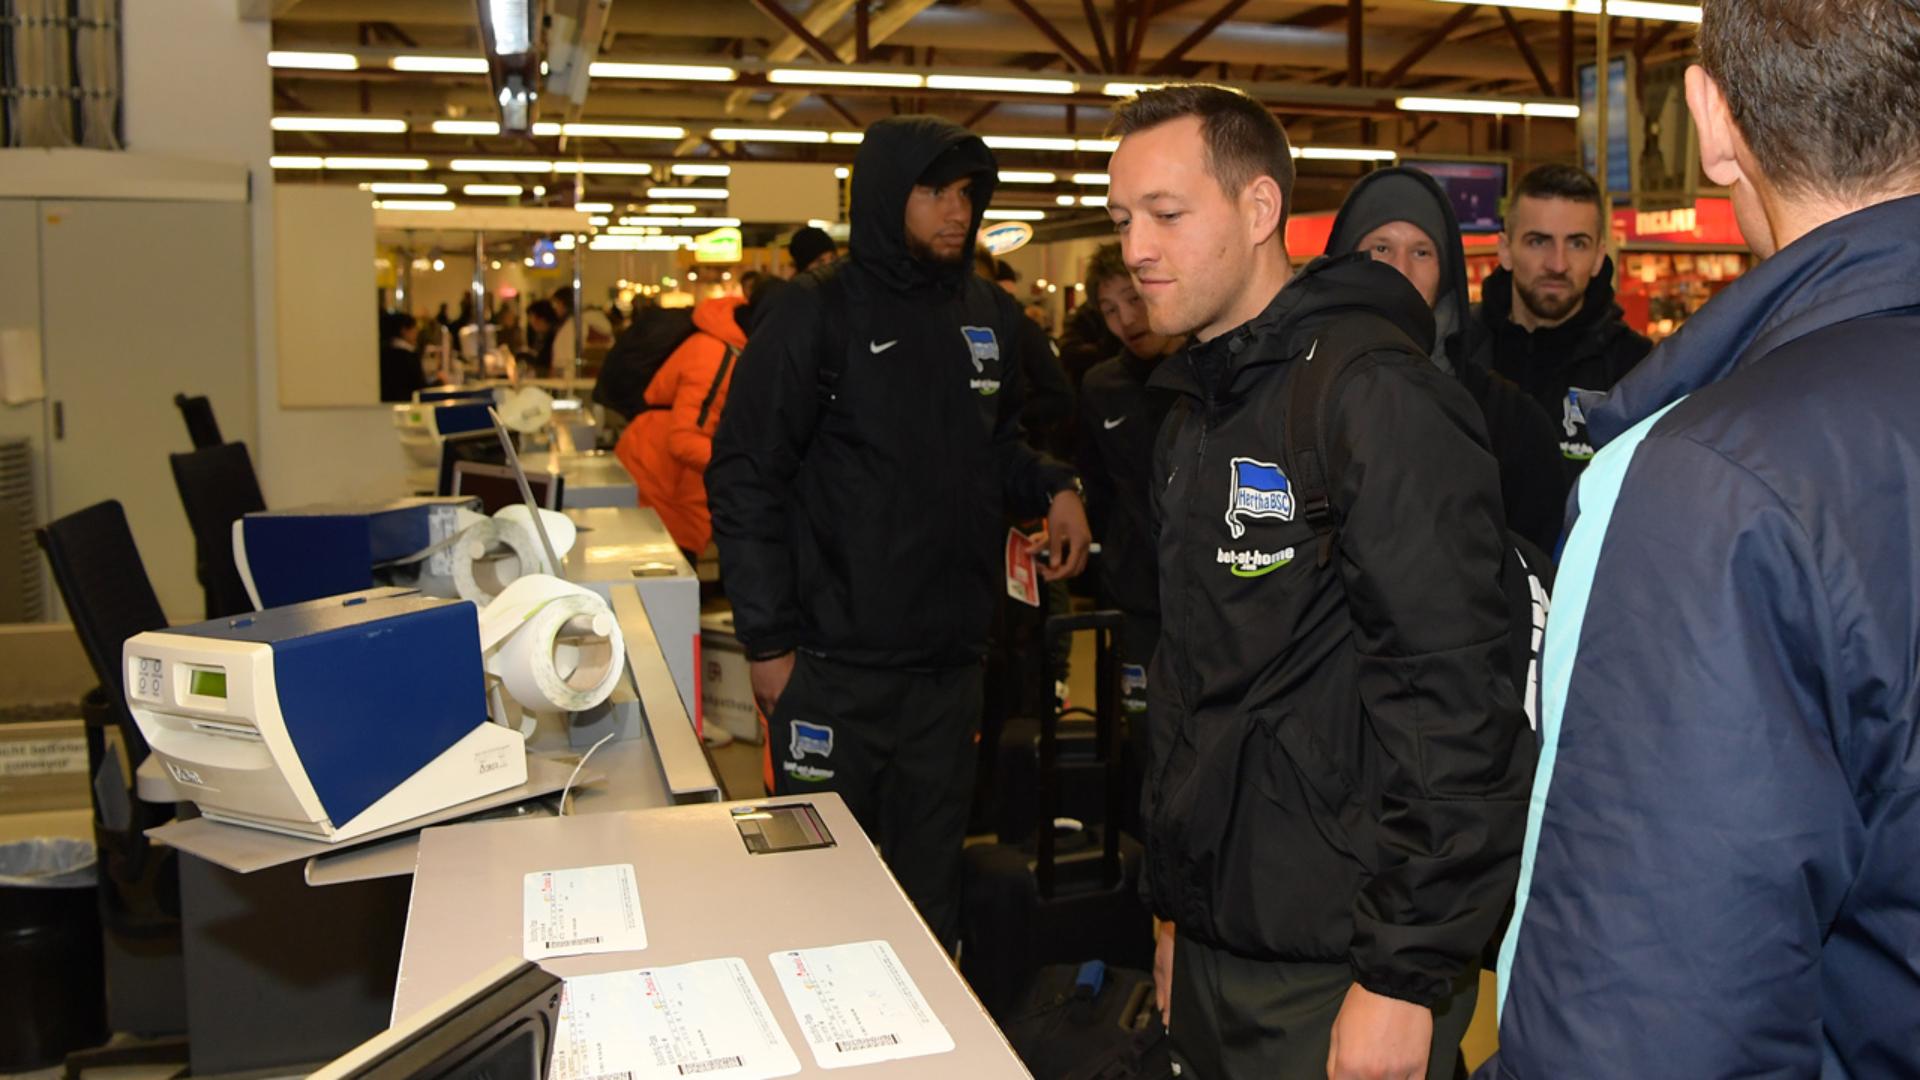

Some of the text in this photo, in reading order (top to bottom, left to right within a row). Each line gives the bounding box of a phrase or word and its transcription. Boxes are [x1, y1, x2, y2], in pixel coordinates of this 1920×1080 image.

[1238, 490, 1289, 513] Hertha BSC
[1216, 546, 1295, 566] bet-at-home
